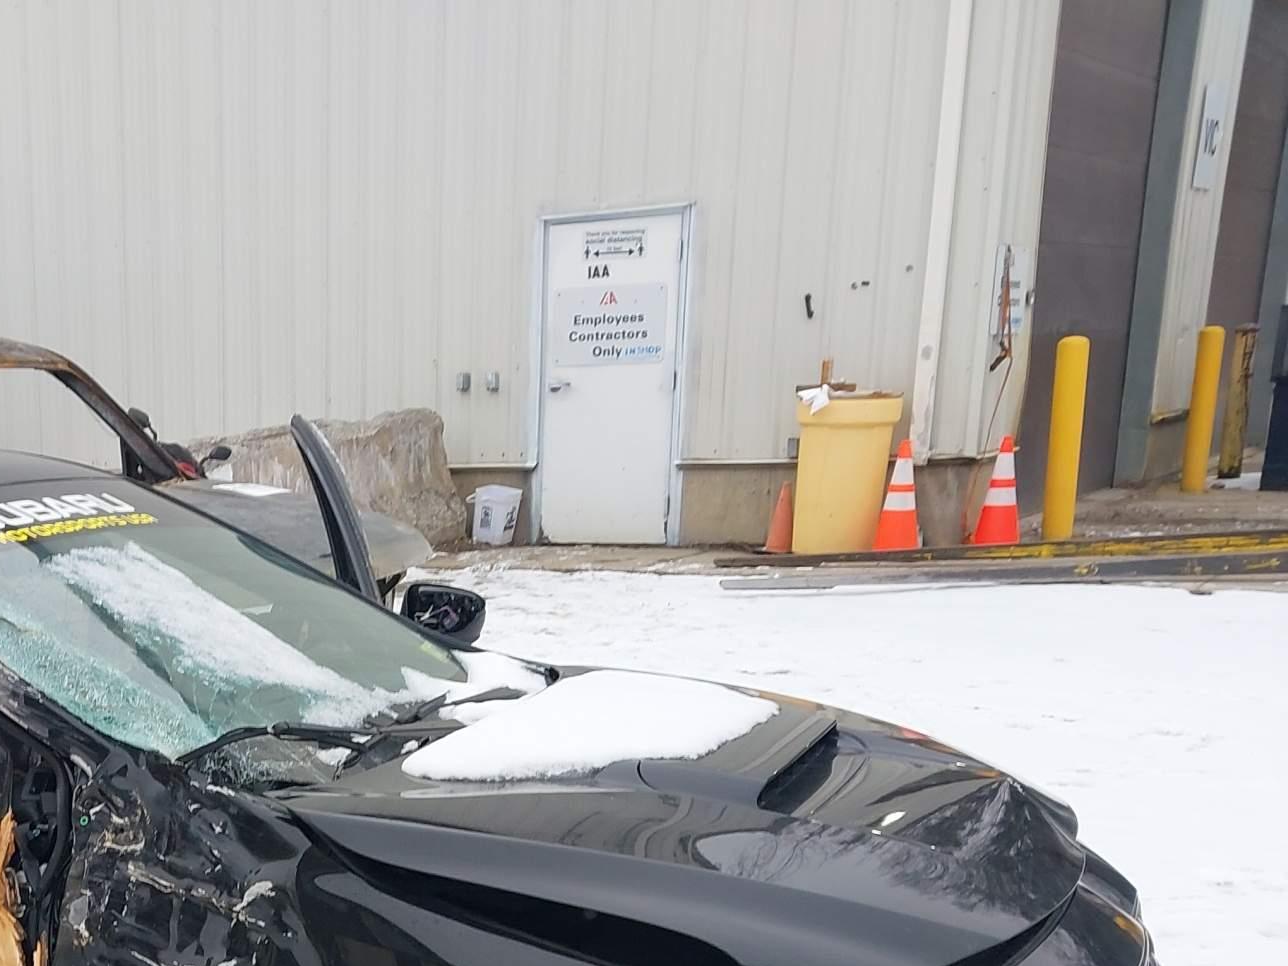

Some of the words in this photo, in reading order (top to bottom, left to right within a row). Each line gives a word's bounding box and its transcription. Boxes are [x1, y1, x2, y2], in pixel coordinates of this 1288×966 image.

[588, 264, 610, 280] IAA
[573, 313, 645, 328] Employees
[568, 329, 649, 342] Contractors
[592, 345, 623, 360] Only
